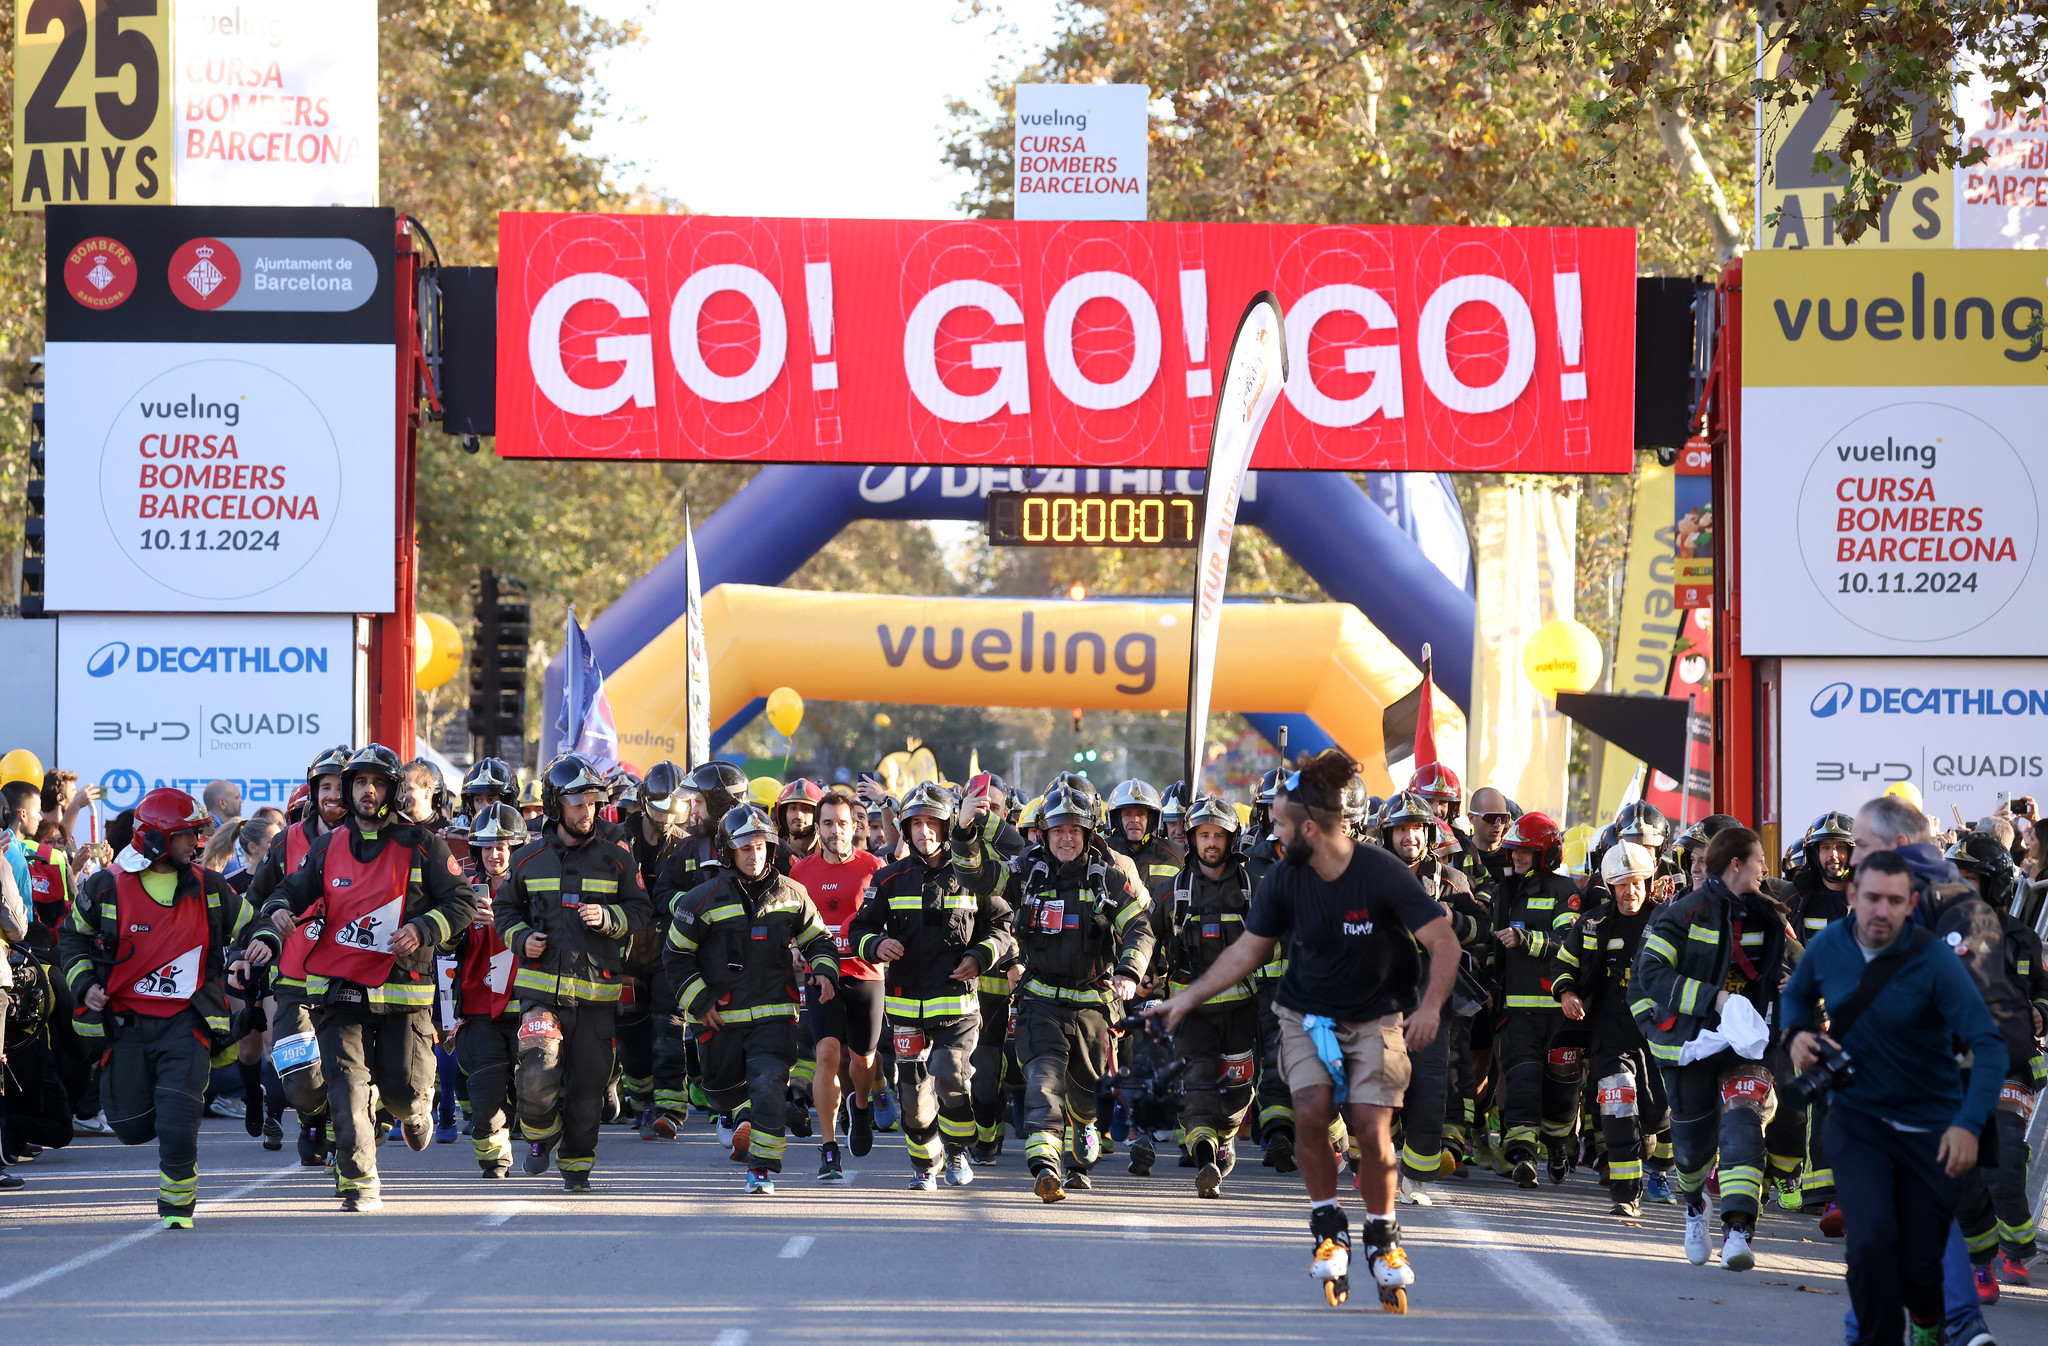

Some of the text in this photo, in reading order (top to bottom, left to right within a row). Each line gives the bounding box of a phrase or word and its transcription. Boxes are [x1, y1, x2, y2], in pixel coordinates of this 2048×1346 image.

[24, 0, 159, 144] 25
[185, 55, 283, 88] CURSA
[1021, 108, 1087, 131] vueling
[186, 128, 361, 165] BARCELONA
[1020, 136, 1086, 153] CURSA
[1967, 137, 2048, 169] BOMB
[22, 146, 158, 202] ANYS
[1020, 156, 1118, 173] BOMBERS
[1020, 177, 1140, 194] BARCELONA
[70, 240, 131, 266] BOMBERS
[255, 257, 352, 272] Ajuntament de
[254, 274, 352, 291] Barcelona
[77, 290, 125, 306] BARCELONA
[1774, 271, 2044, 362] vueling
[528, 263, 838, 416] GO!
[903, 268, 1213, 424] GO!
[1284, 272, 1588, 428] GO!
[140, 393, 240, 426] vueling
[139, 434, 239, 459] CURSA
[1837, 436, 1937, 469] vueling
[139, 464, 286, 490] BOMBERS
[1836, 477, 1936, 502] CURSA
[139, 494, 320, 520] BARCELONA
[1836, 507, 1984, 532] BOMBERS
[1023, 498, 1194, 543] 00:00:07
[140, 529, 280, 551] 10.11.2024
[1836, 537, 2018, 562] BARCELONA
[1838, 572, 1978, 594] 10.11.2024
[1622, 525, 1679, 698] vuelin
[136, 646, 328, 673] DECATHLON
[877, 611, 1156, 695] vueling
[1535, 658, 1577, 673] vueling
[1860, 687, 2048, 716] DECATHLON
[93, 713, 320, 741] BYD QUADIS
[211, 739, 251, 751] Dream
[618, 729, 675, 753] vueling
[1816, 754, 2043, 782] BYD QUADIS
[1933, 780, 1974, 792] Dream
[282, 1044, 307, 1062] 2975
[1562, 1050, 1577, 1060] 423
[1605, 1089, 1622, 1100] 314
[1735, 1080, 1755, 1092] 418
